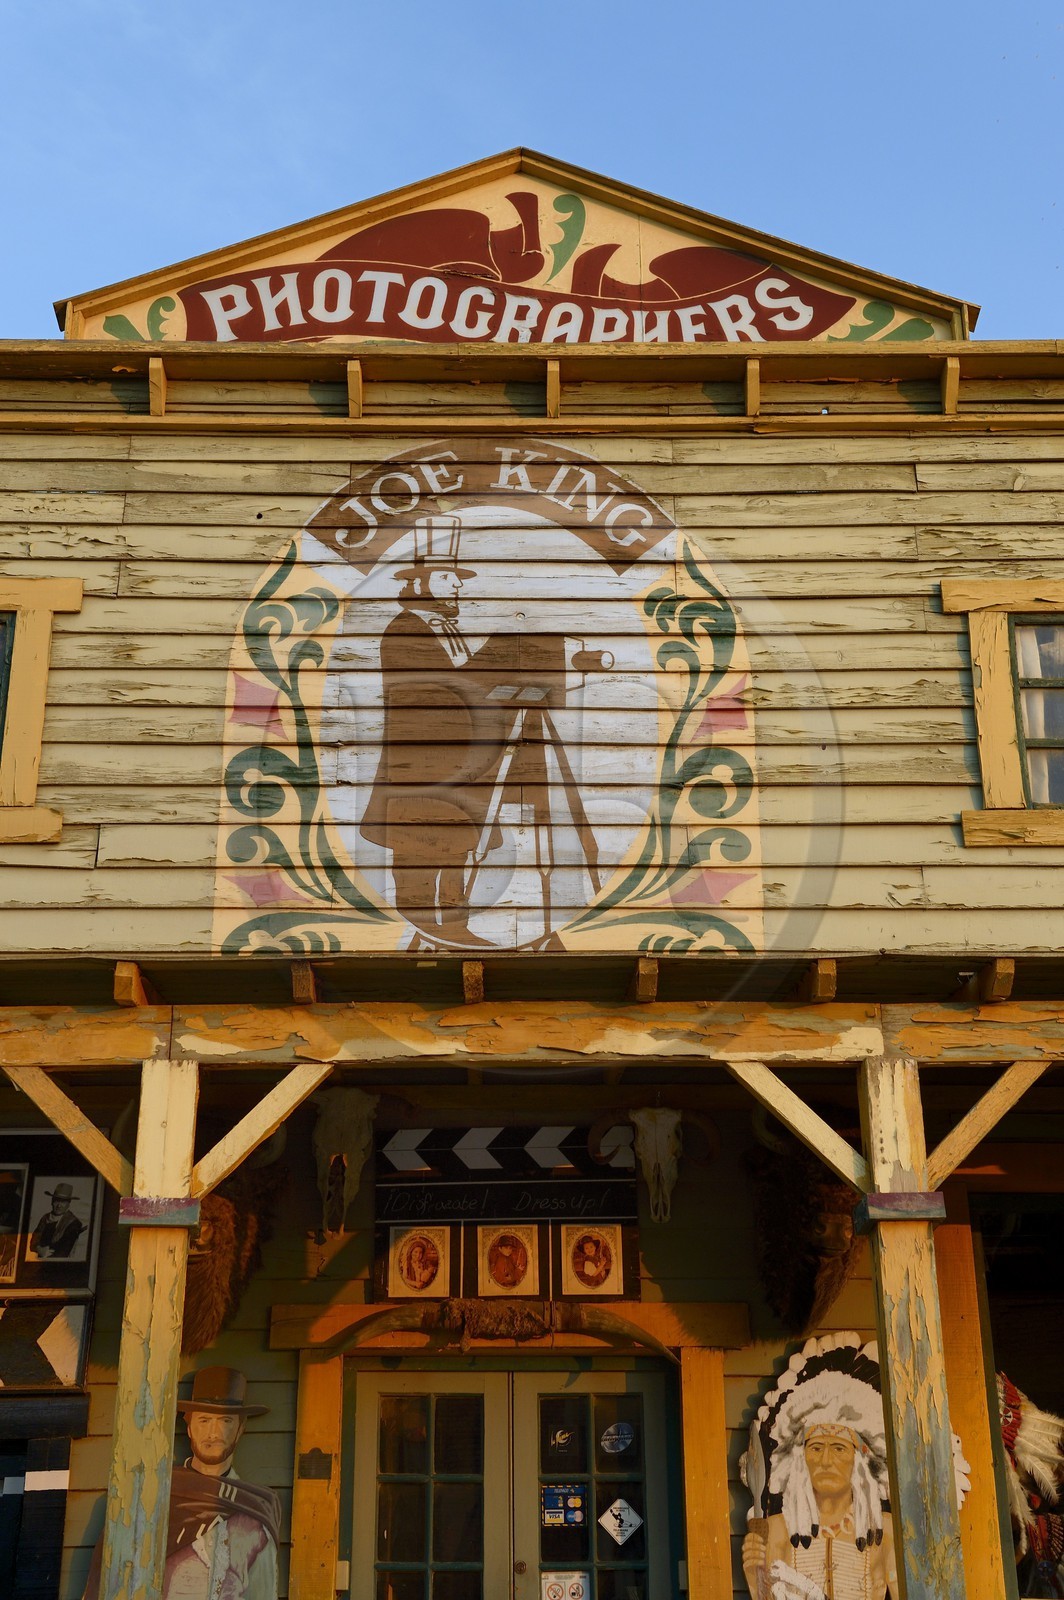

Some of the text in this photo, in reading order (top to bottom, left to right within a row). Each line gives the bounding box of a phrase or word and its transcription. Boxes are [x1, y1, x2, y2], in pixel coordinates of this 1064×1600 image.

[200, 268, 814, 342] PHOTOGRAPHERS
[335, 447, 654, 548] JOE KING
[512, 1191, 567, 1212] Dress
